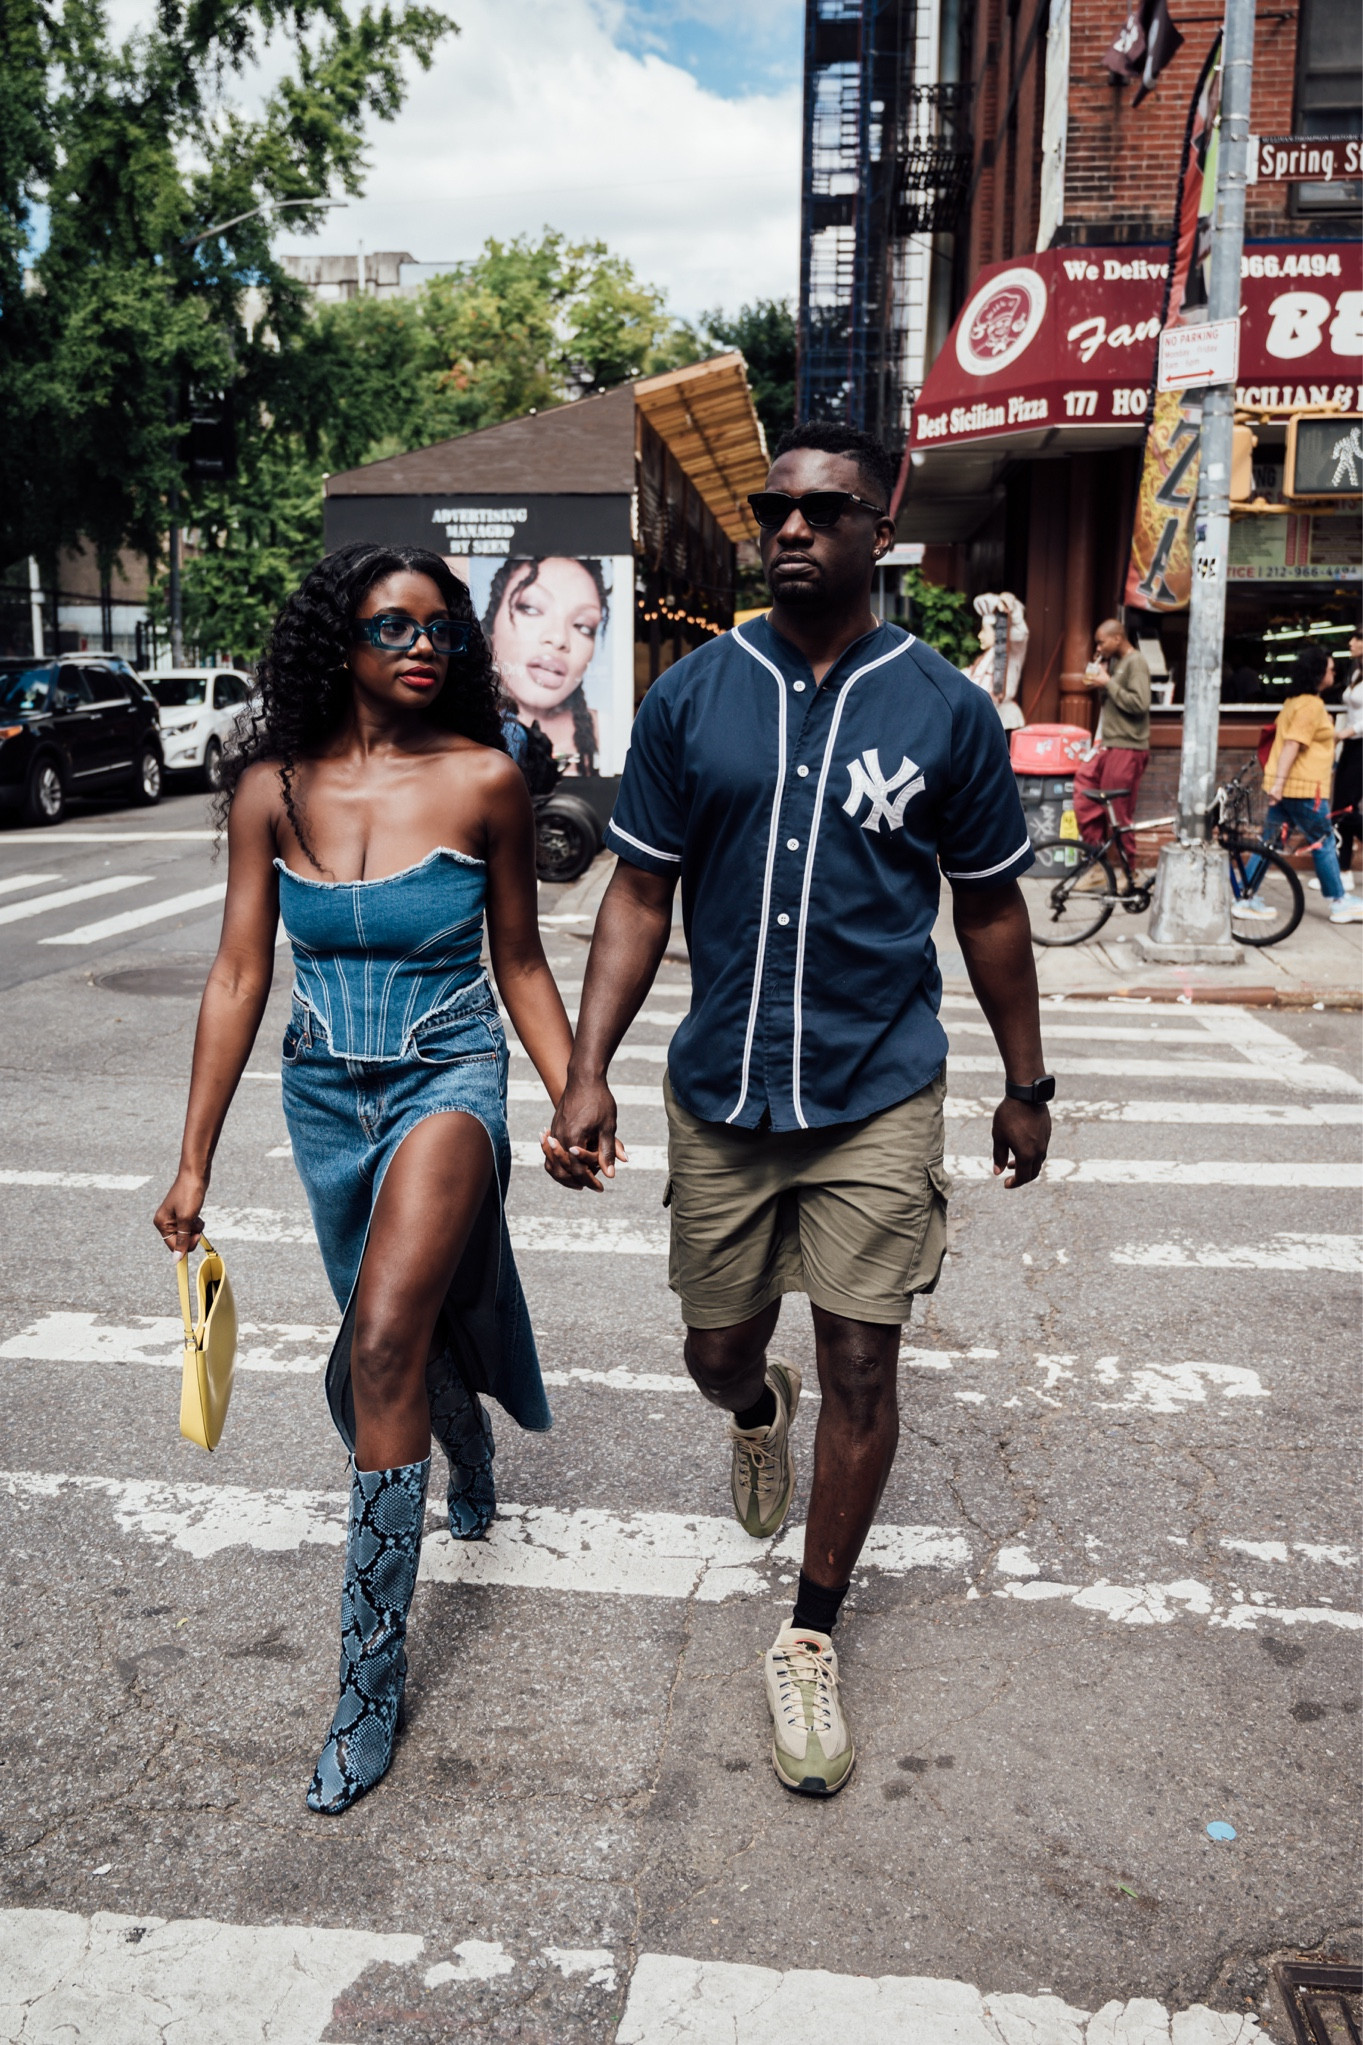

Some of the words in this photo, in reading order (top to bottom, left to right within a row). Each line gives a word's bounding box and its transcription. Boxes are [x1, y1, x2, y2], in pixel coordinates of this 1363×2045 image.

[1261, 144, 1334, 181] Spring
[1063, 260, 1099, 281] We
[1103, 259, 1169, 280] Delive
[1165, 336, 1178, 346] NO
[1180, 329, 1219, 343] PARKING
[1063, 390, 1098, 416] 177
[1112, 388, 1150, 415] HO
[1235, 385, 1330, 407] ICILIAN
[917, 413, 948, 440] Best
[950, 402, 1006, 434] Sicilian
[1007, 395, 1048, 424] Pizza
[432, 508, 528, 523] ADVERTISING
[446, 524, 515, 538] MANAGED
[450, 540, 470, 554] BY
[472, 539, 510, 554] SEEN
[1227, 566, 1256, 578] TICE
[842, 748, 926, 834] NY
